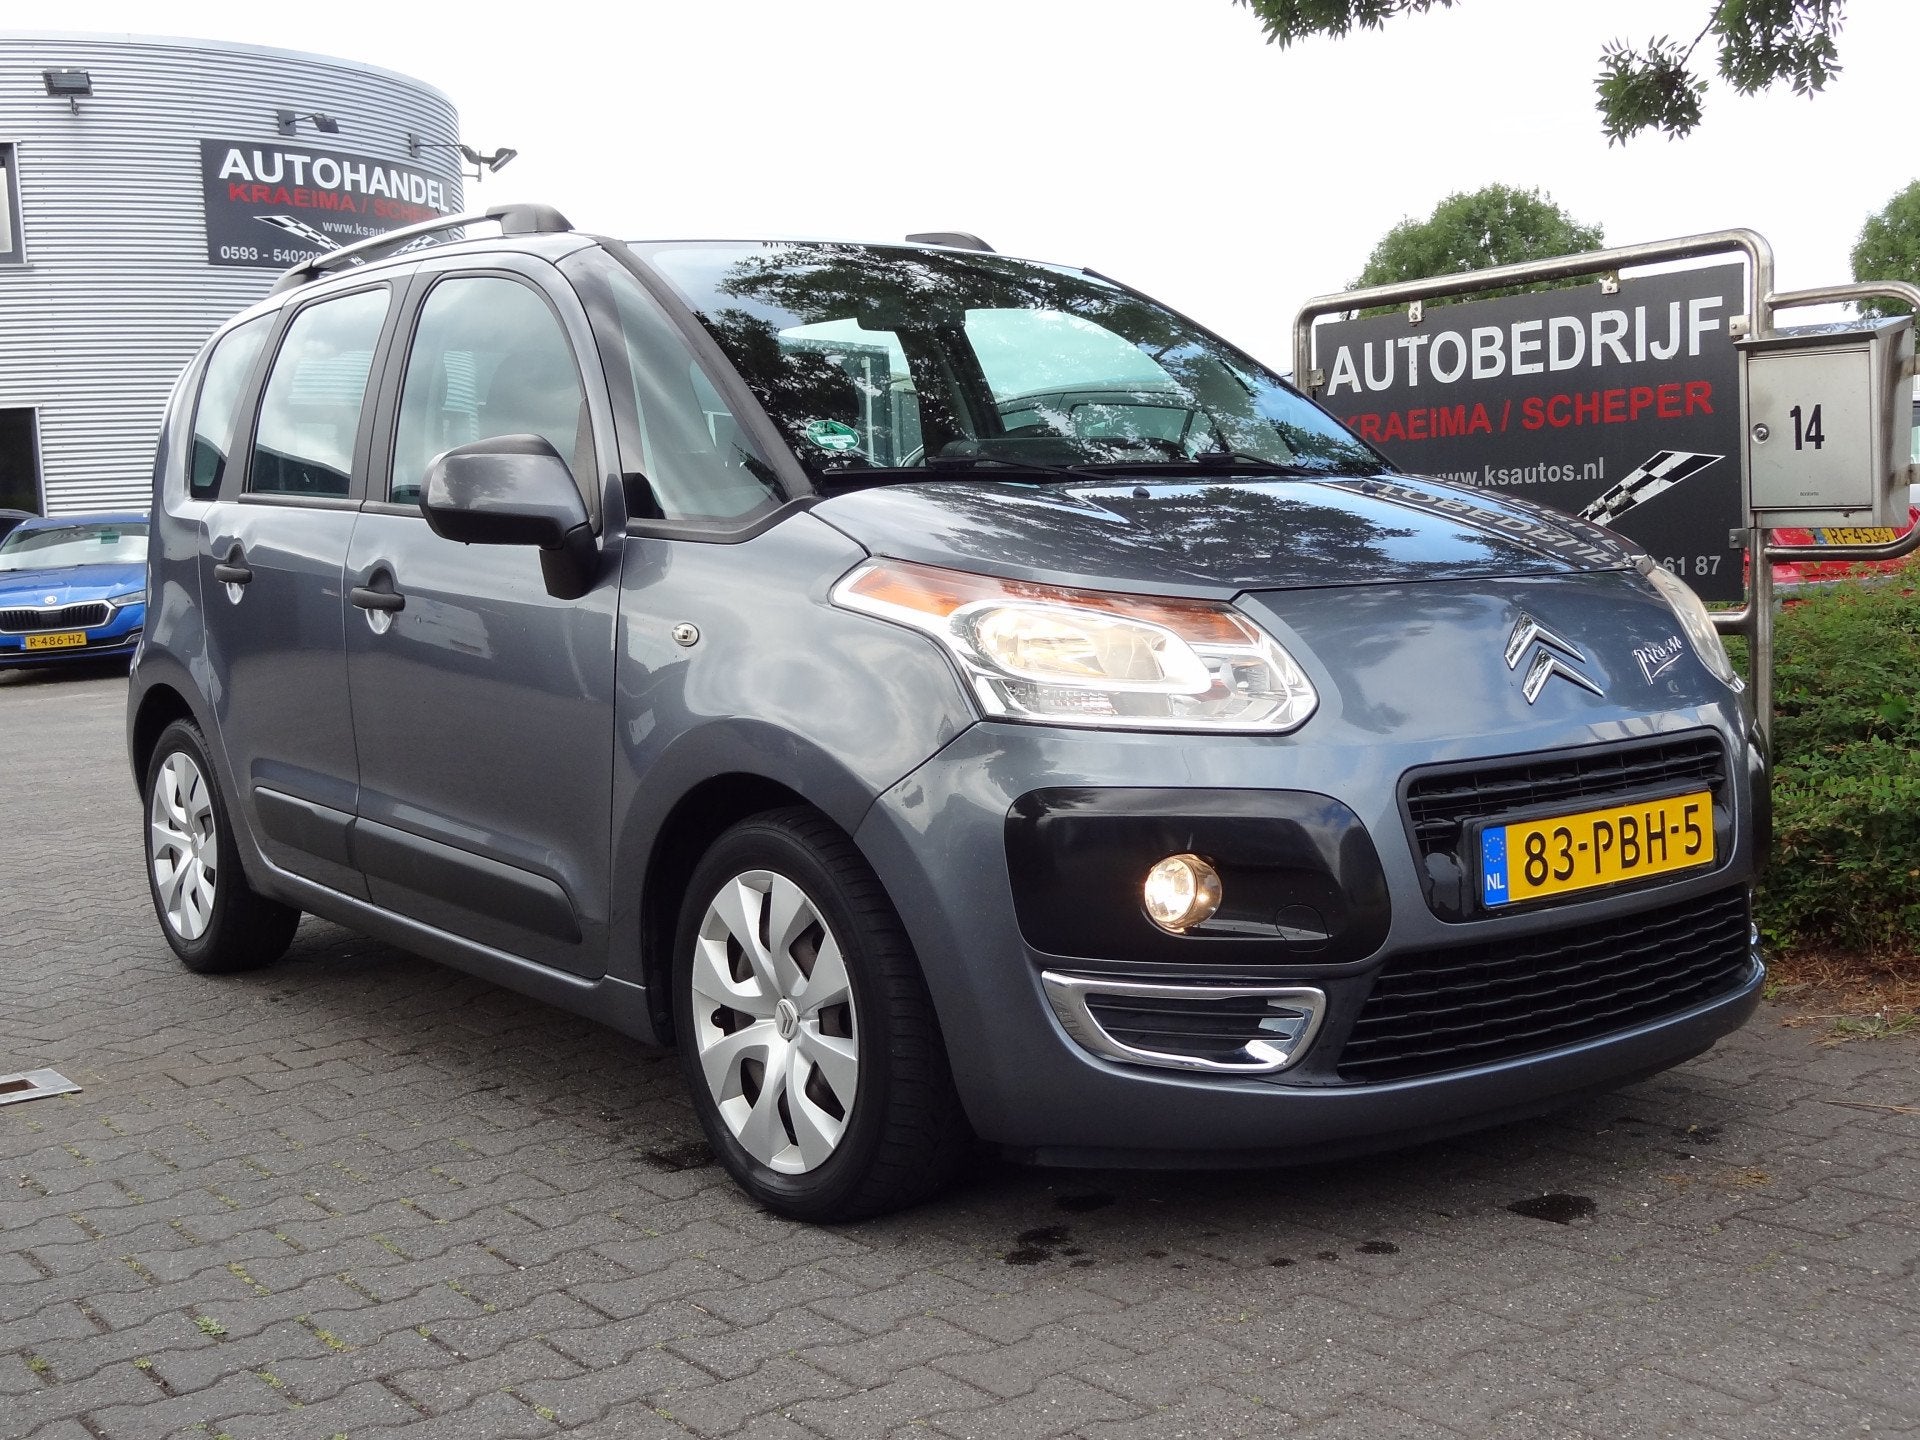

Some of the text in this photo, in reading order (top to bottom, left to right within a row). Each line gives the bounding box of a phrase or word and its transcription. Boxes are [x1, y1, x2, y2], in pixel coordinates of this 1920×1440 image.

[218, 148, 449, 213] AUTOHANDEL
[228, 182, 357, 213] KRAEIMA
[322, 221, 389, 236] www.ksaut
[220, 246, 258, 260] 0593
[1327, 296, 1723, 396] AUTOBEDRIJF
[1521, 380, 1714, 430] SCHEPER
[1790, 404, 1825, 450] 14
[1432, 457, 1604, 486] ww.ksautos.nl
[1663, 555, 1721, 576] 61 87
[30, 634, 83, 647] R-486-HZ
[1524, 804, 1702, 887] 83-PBH-5
[1486, 873, 1505, 891] NL
